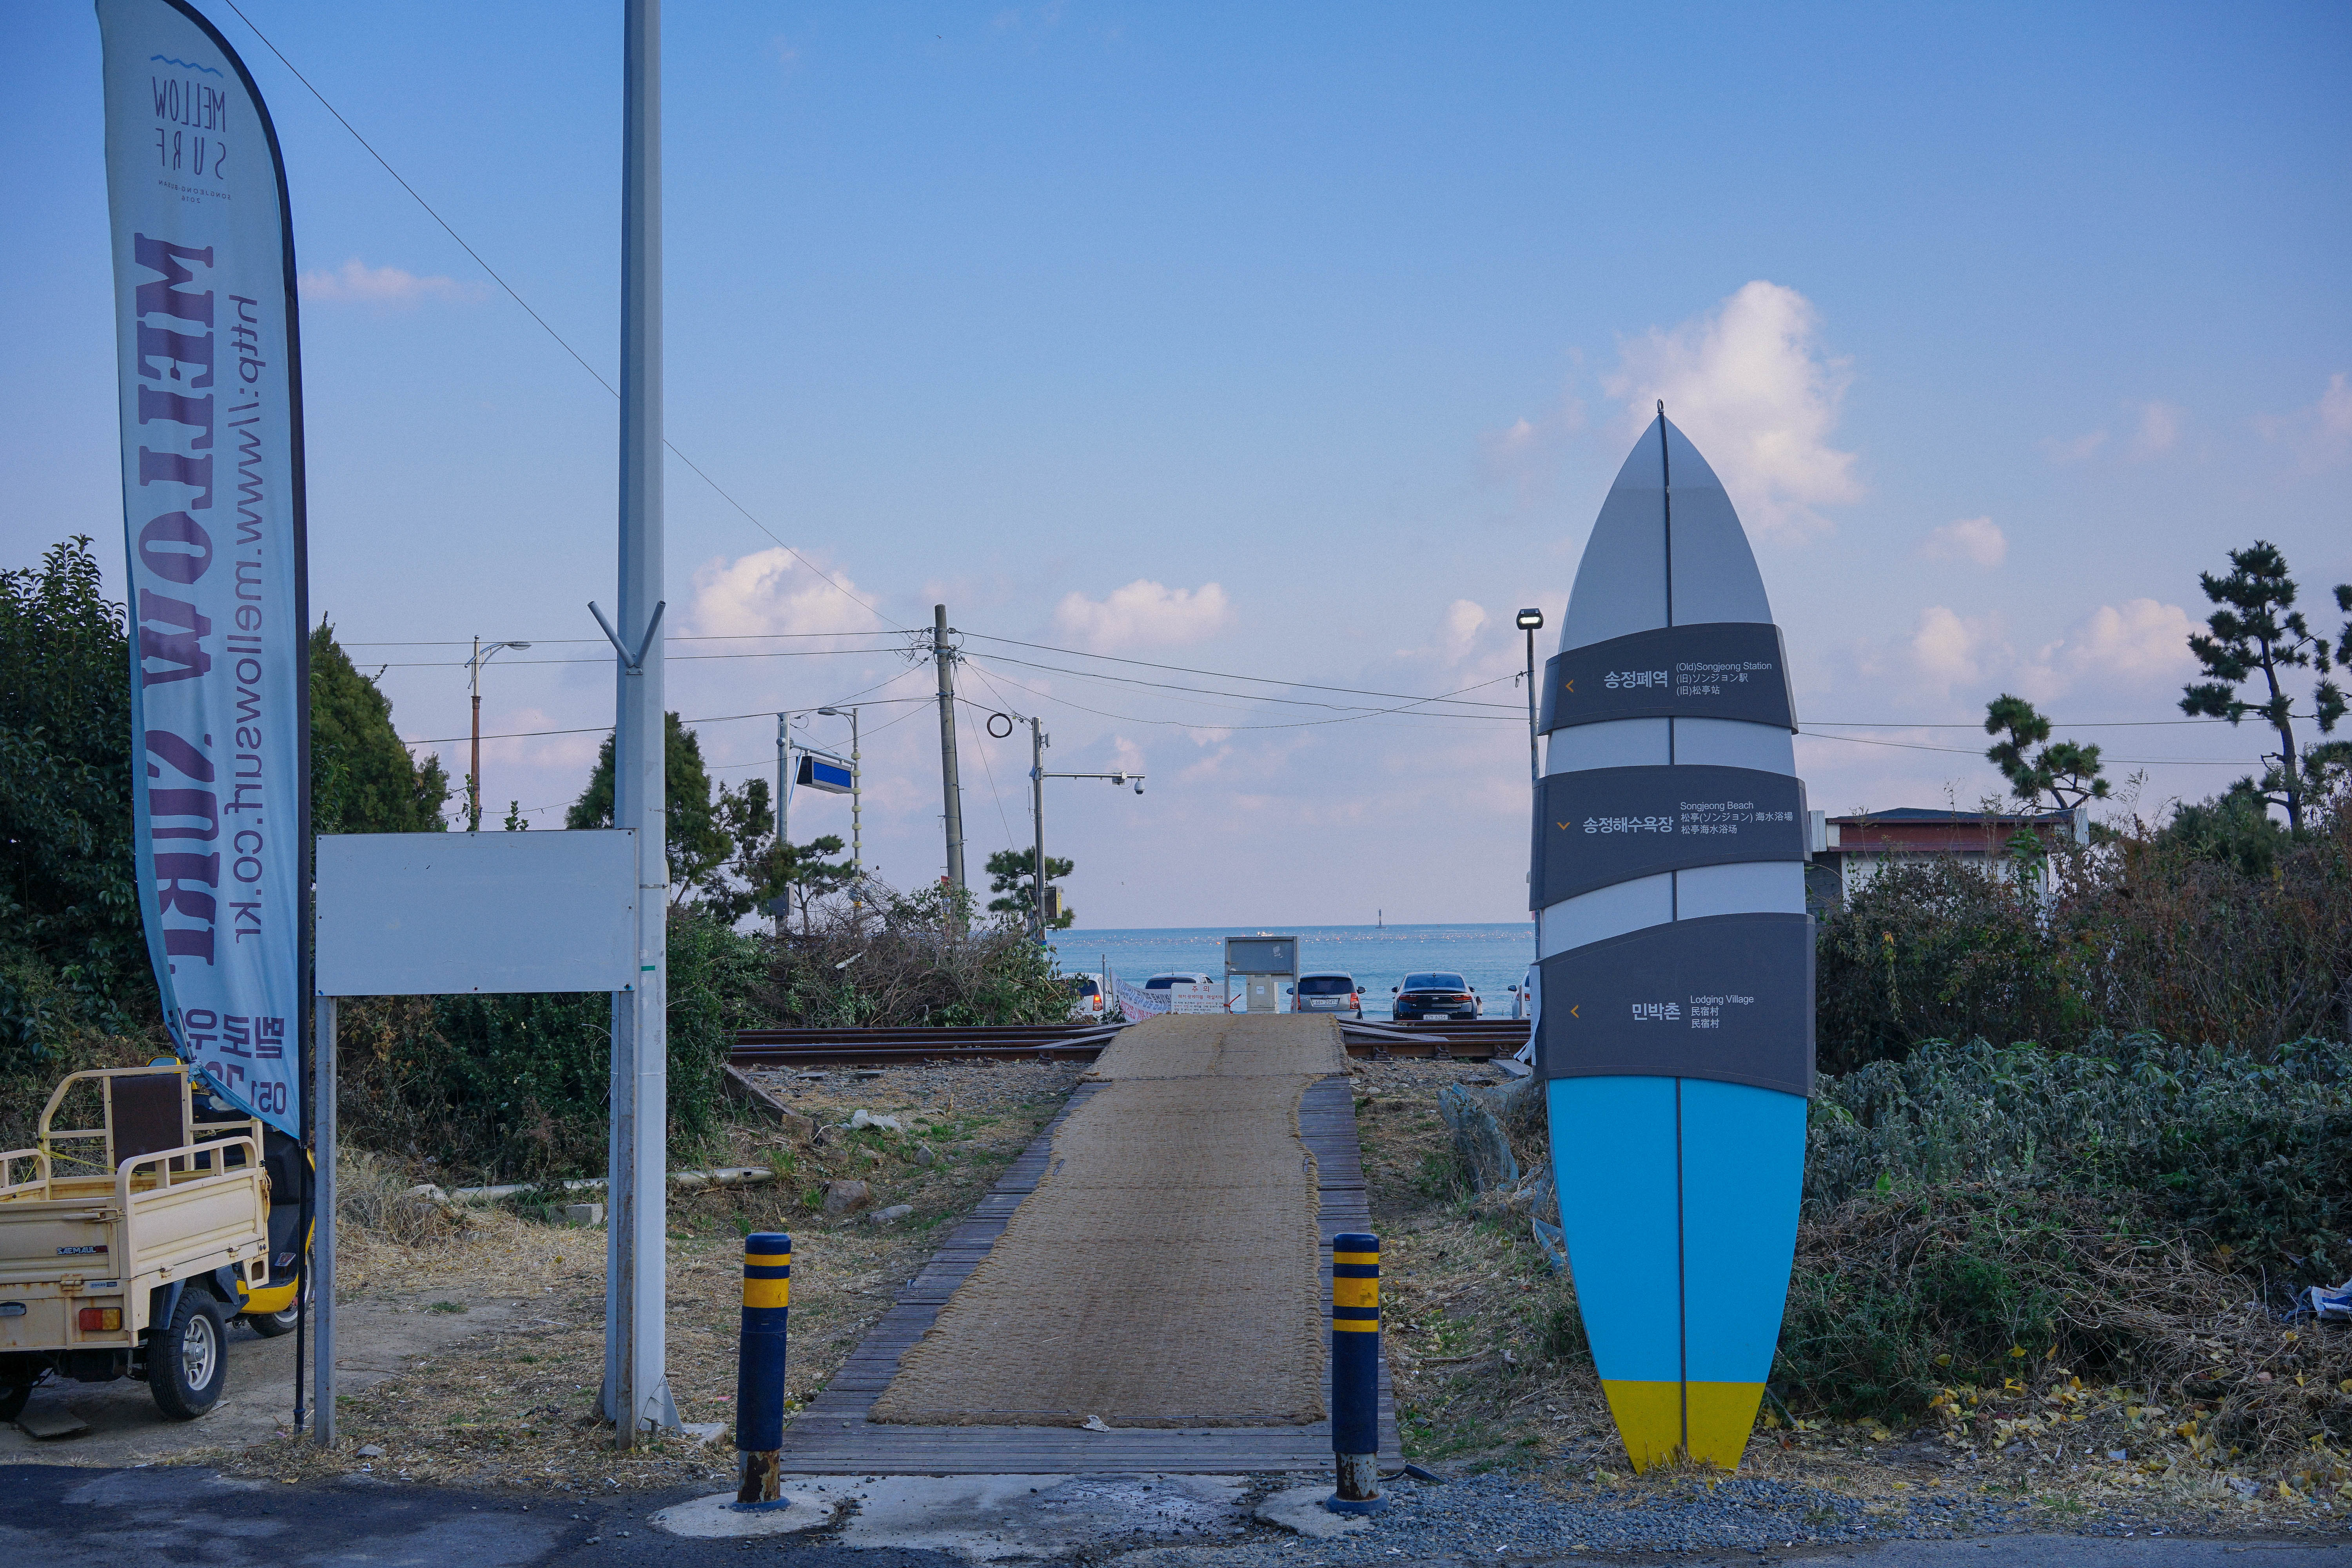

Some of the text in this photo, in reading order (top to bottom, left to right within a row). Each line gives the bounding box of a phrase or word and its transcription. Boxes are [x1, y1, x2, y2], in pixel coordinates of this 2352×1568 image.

[1676, 662, 1772, 672] (Old)Songjeong Station
[1604, 671, 1668, 689] 송정폐역
[1677, 685, 1720, 696] (旧)松亭站
[1681, 801, 1754, 812] Songjeong Beach
[1583, 816, 1673, 834] 송정해수욕장
[1690, 995, 1754, 1005] Lodging Village
[1632, 1002, 1681, 1020] 민박촌
[1691, 1006, 1719, 1016] 民宿村
[1691, 1018, 1720, 1028] 民宿村
[57, 1246, 97, 1255] SAEMAUL
